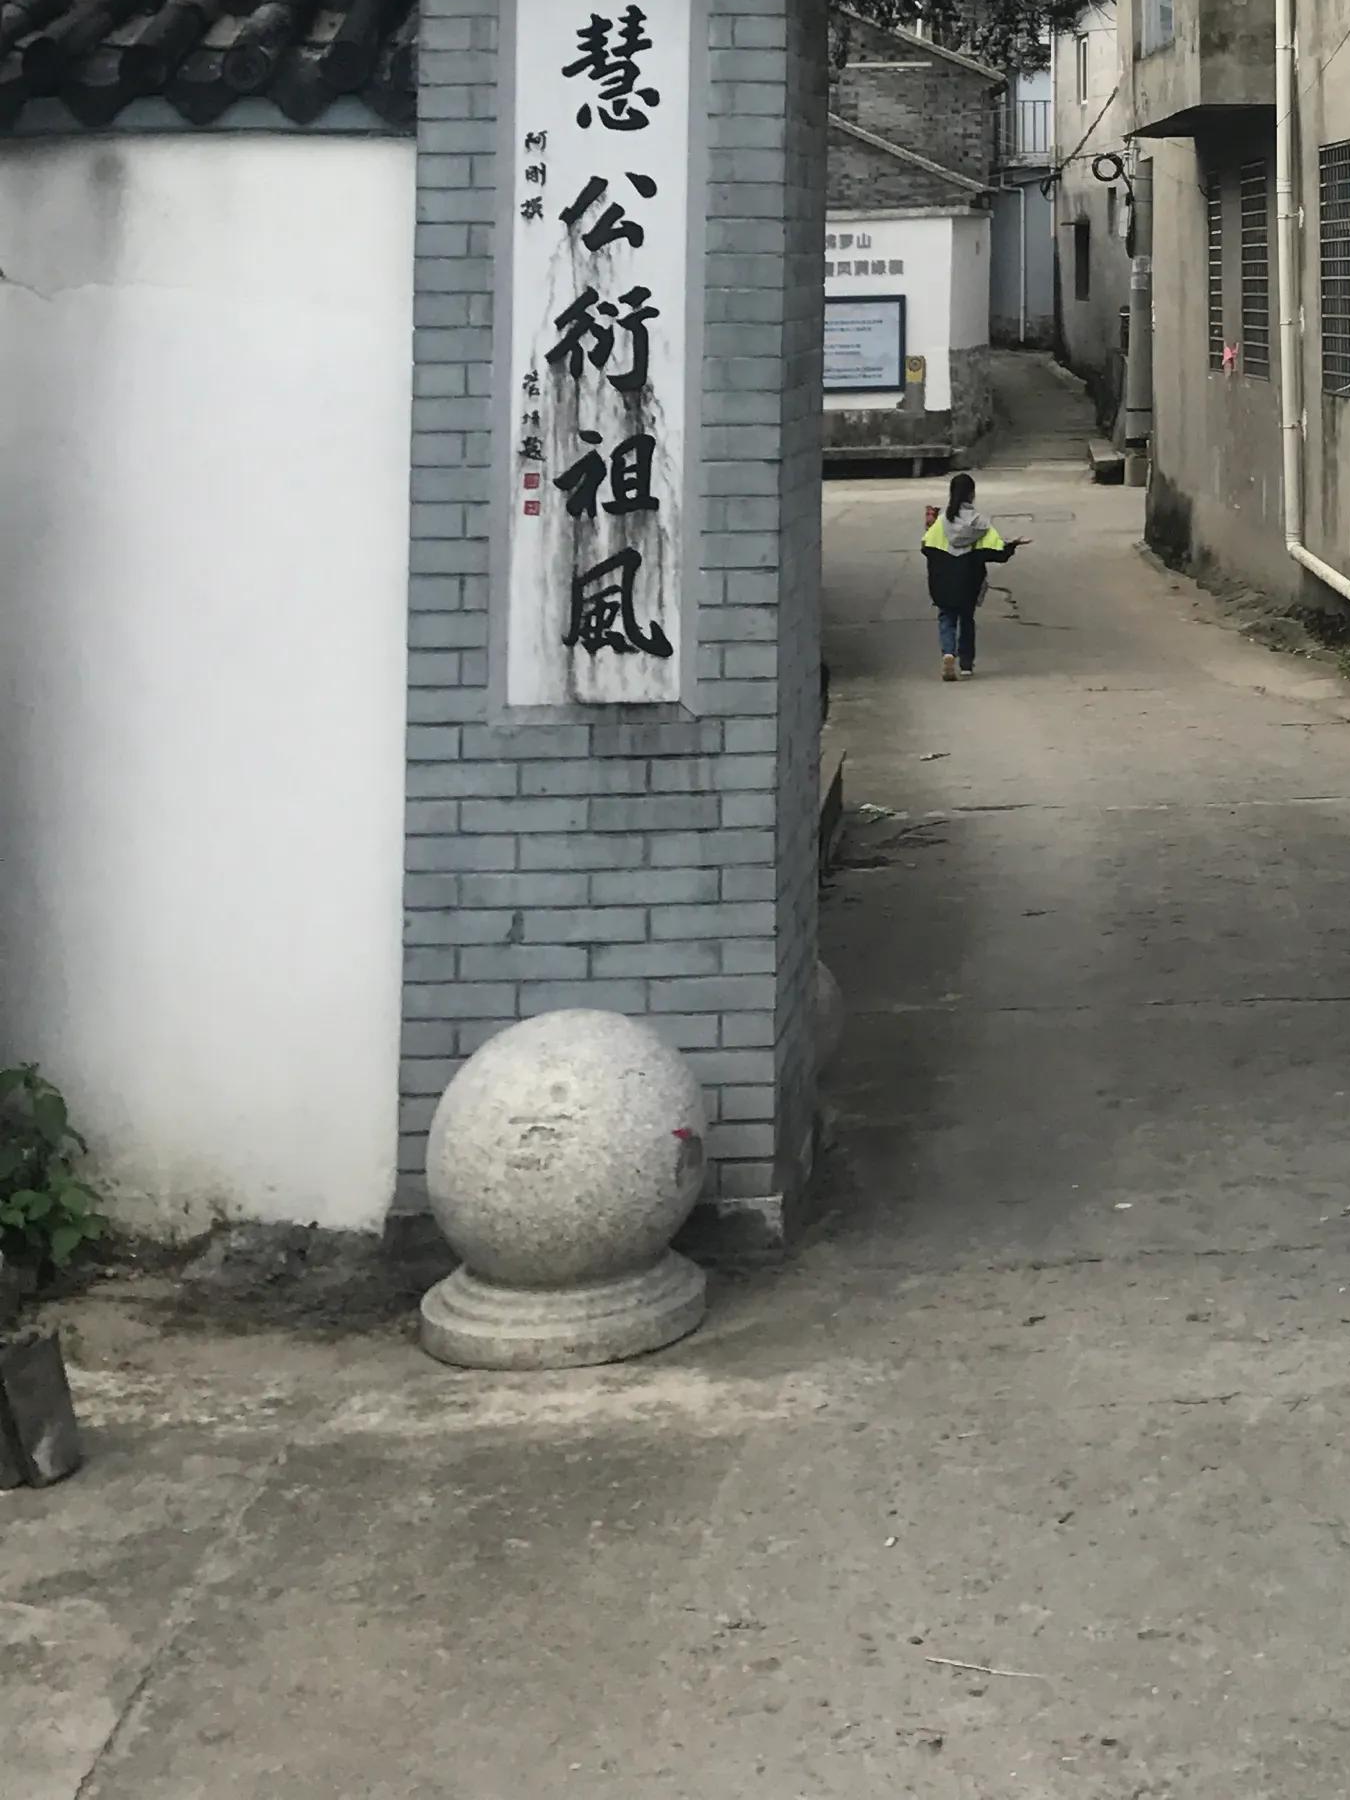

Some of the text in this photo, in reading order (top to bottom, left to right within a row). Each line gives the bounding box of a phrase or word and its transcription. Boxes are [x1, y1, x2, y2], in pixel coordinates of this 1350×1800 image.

[544, 4, 675, 659] 慧公衍祖風
